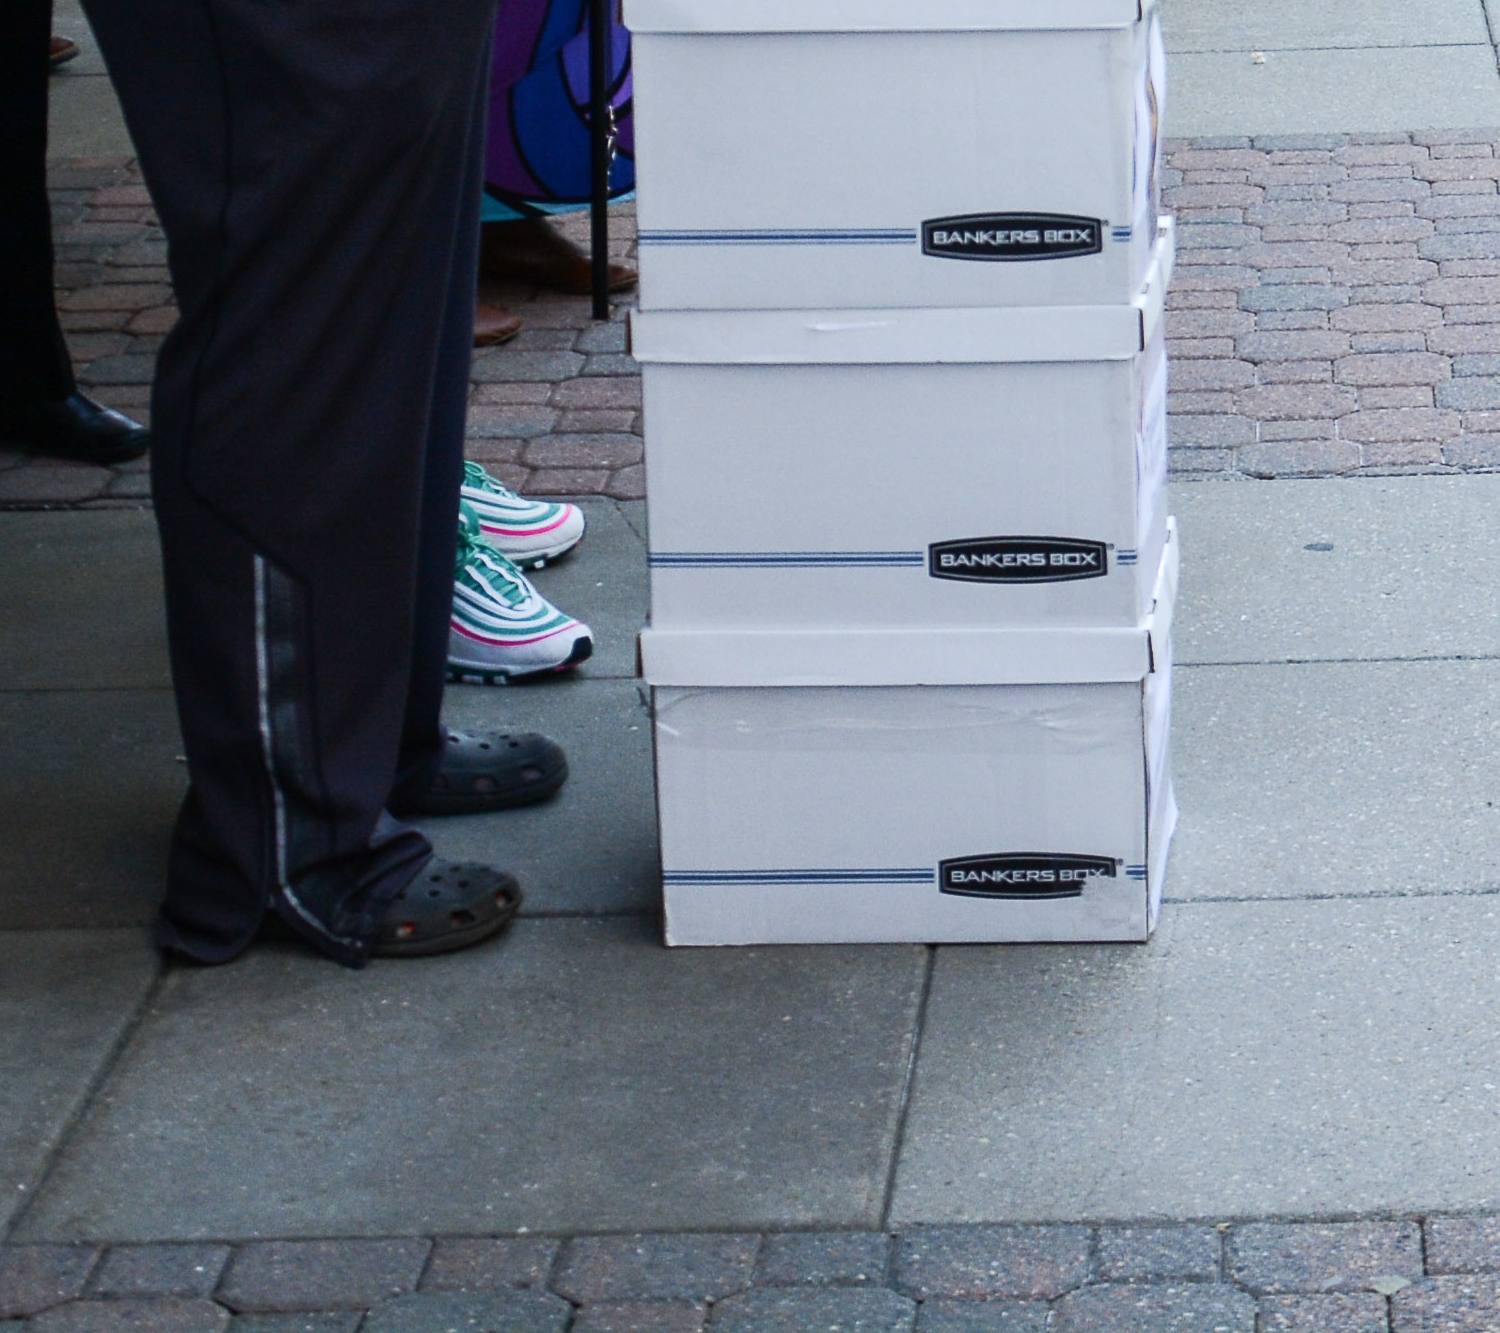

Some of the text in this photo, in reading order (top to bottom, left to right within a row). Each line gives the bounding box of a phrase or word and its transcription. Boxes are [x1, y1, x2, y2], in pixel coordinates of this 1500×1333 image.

[933, 229, 1092, 245] BANKERS BOX
[940, 552, 1097, 568] BANKERS BOX
[951, 869, 1056, 884] BANKERS
